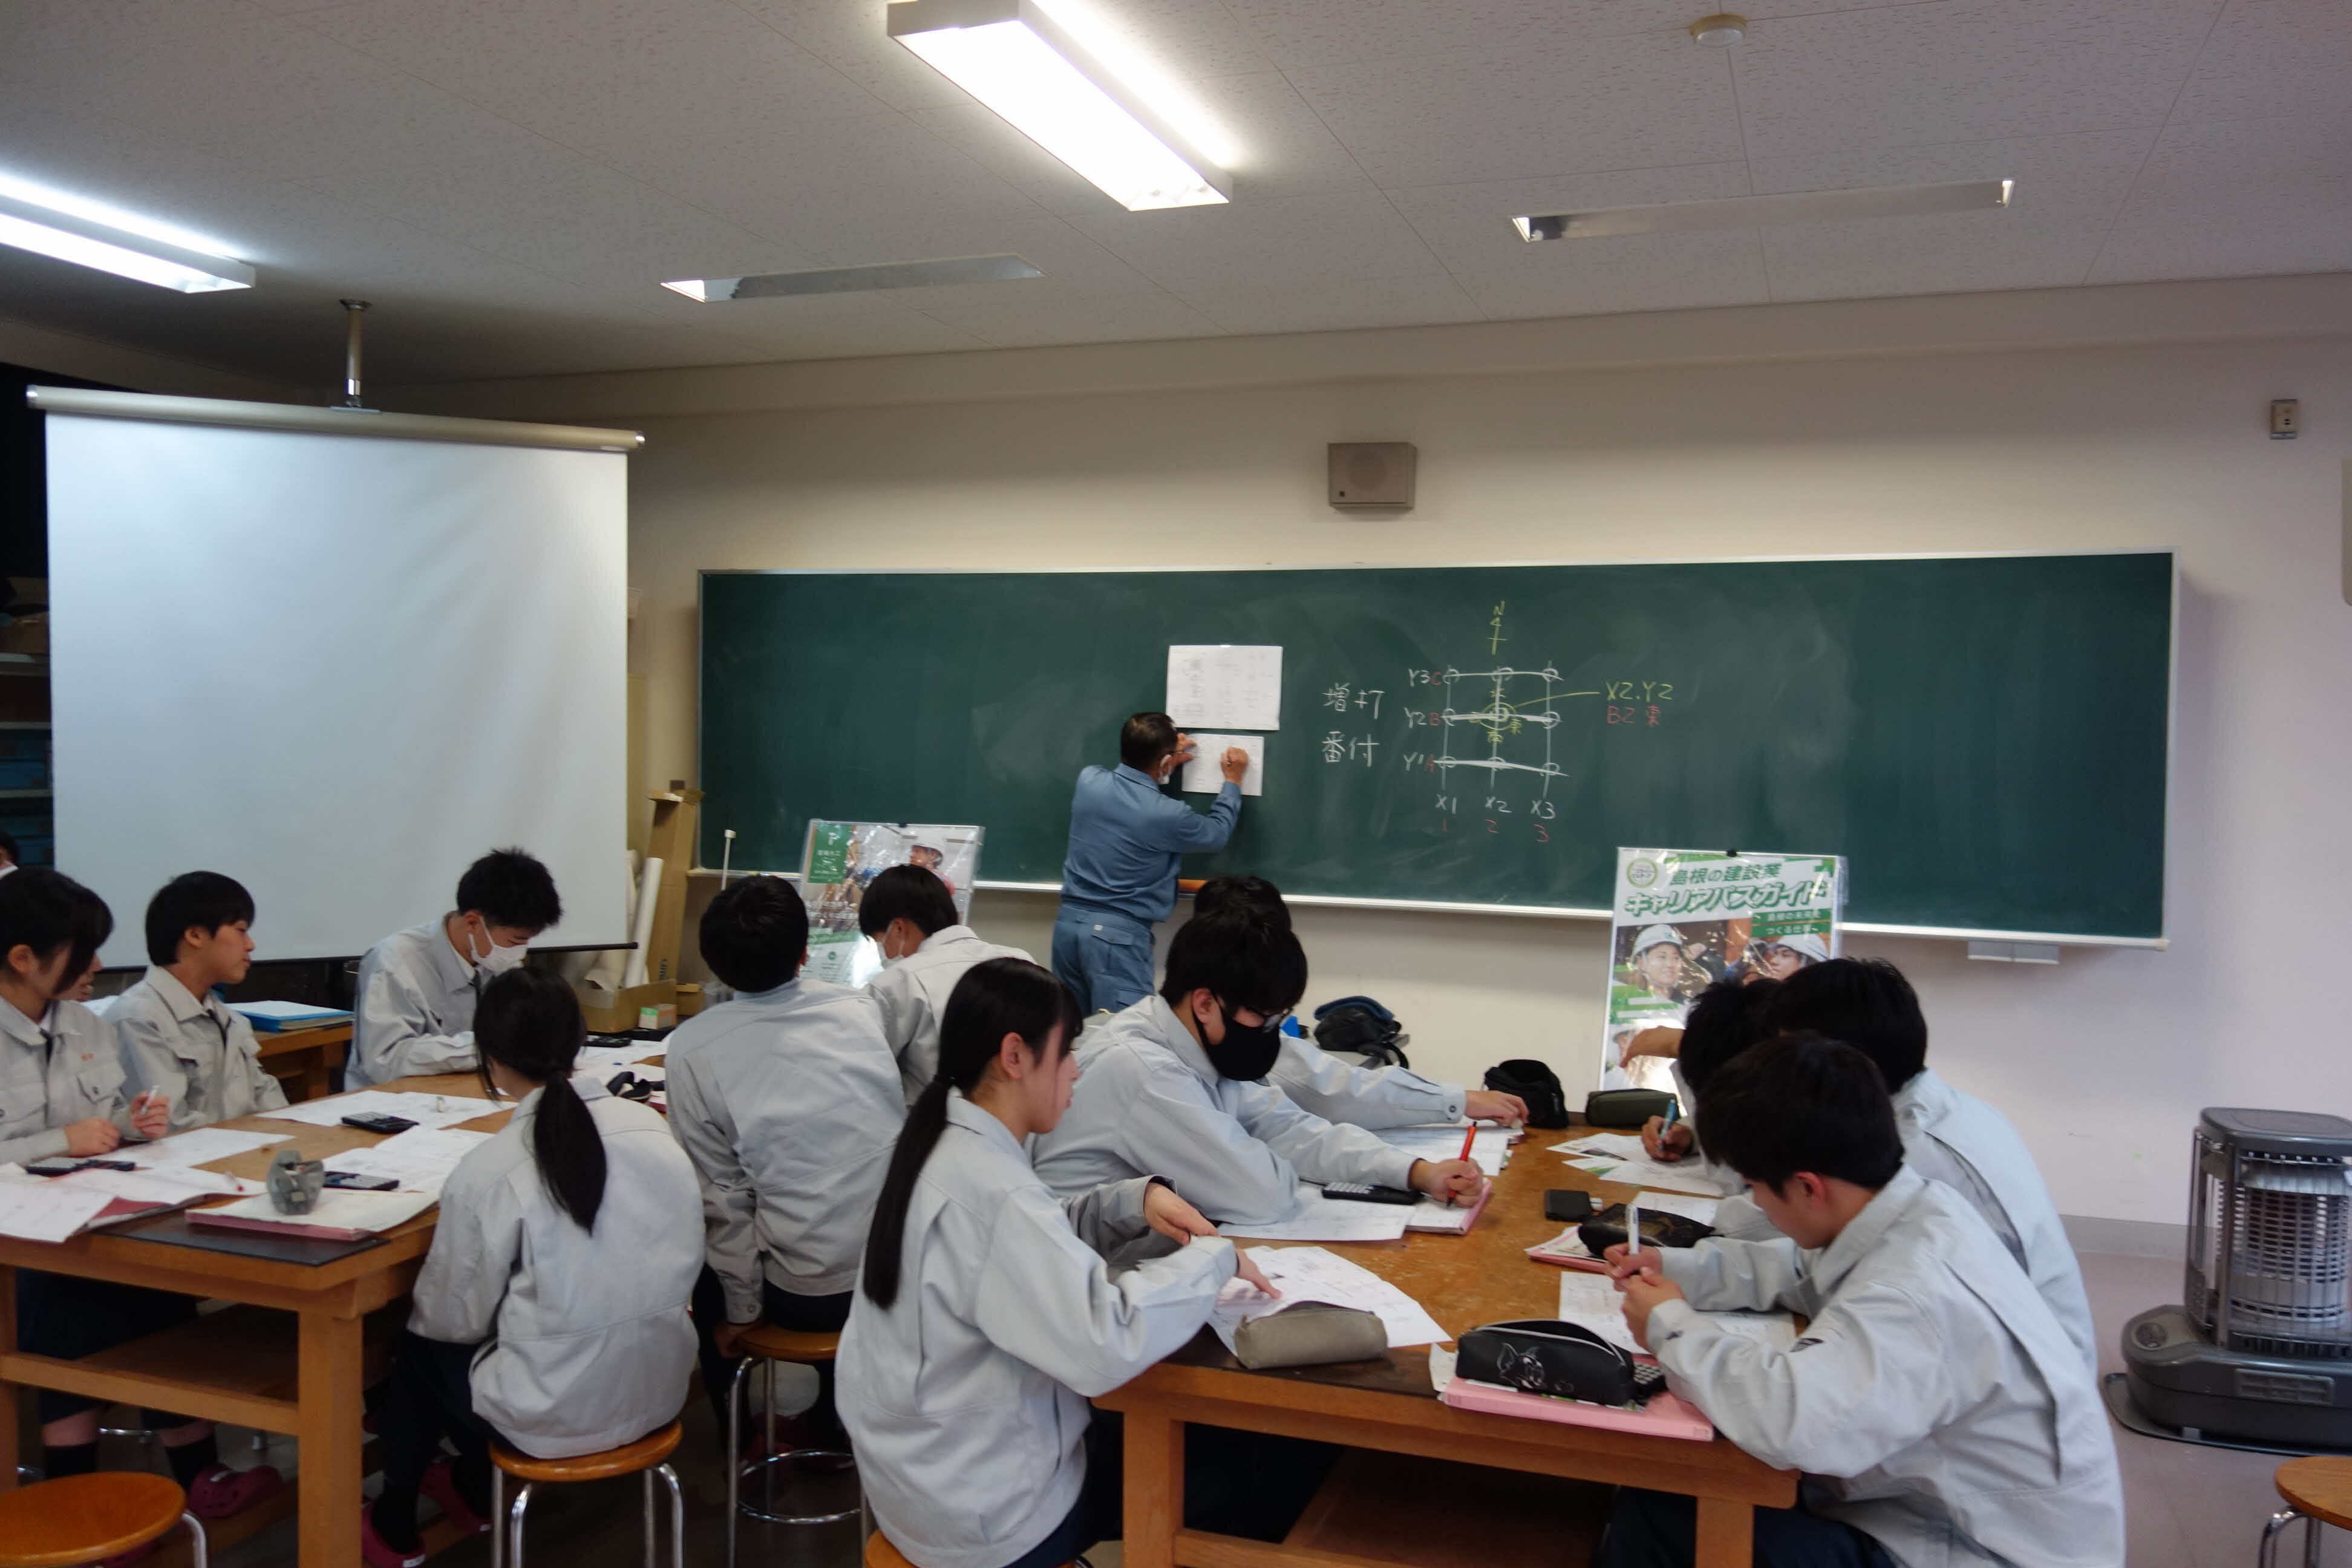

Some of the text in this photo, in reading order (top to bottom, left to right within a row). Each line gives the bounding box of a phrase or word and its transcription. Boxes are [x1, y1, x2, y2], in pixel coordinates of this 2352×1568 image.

[1322, 731, 1380, 768] 番付
[1435, 793, 1557, 819] X1 X2 X3
[1533, 823, 1549, 842] 3
[1670, 863, 1782, 886] 島根の建設業
